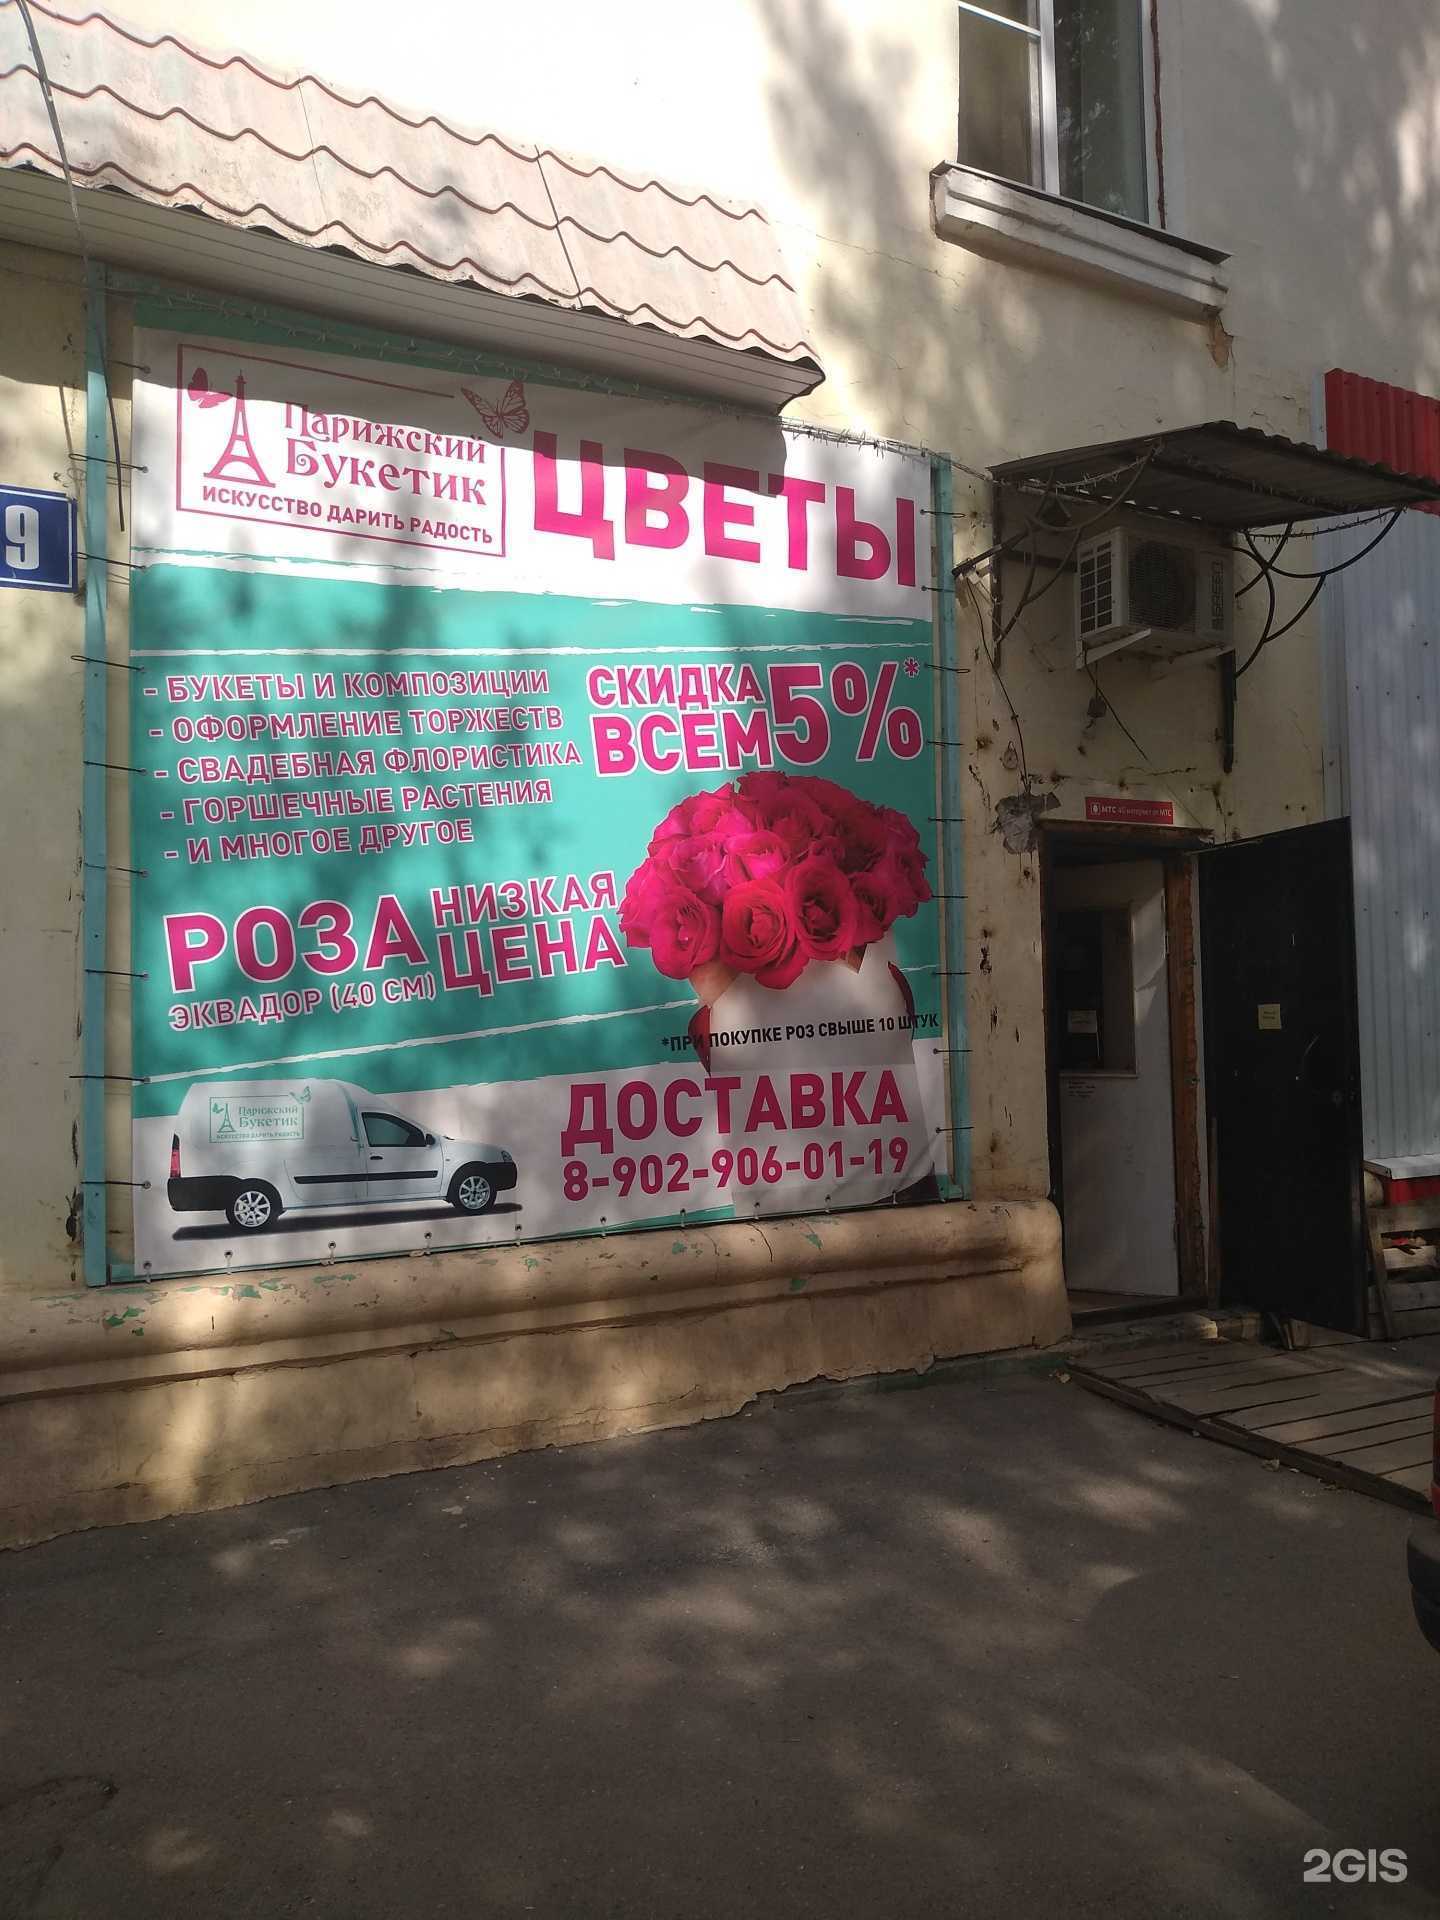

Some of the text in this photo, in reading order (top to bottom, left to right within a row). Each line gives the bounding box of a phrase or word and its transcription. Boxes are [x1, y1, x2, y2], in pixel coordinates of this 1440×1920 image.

[285, 399, 486, 463] Парижский
[286, 437, 487, 506] Букетик
[5, 505, 39, 570] 9
[202, 485, 492, 544] ИСКУССТВО ДАРИТЬ РАДОСТЬ
[533, 430, 916, 587] ЦВЕТЫ
[166, 673, 304, 703] БУКЕТЫ
[313, 673, 336, 699] И
[343, 669, 550, 700] КОМПОЗИЦИИ
[587, 663, 766, 711] СКИДКА
[172, 710, 402, 744] ОФОРМЛЕНИЕ
[408, 706, 564, 735] ТОРЖЕСТВ
[590, 708, 774, 776] ВСЕМ
[177, 750, 376, 786] СВАДЕБНАЯ
[384, 741, 582, 776] ФЛОРИСТИКА
[183, 787, 394, 825] ГОРШЕЧНЫЕ
[401, 779, 553, 813] РАСТЕНИЯ
[186, 837, 212, 864] И
[220, 827, 351, 862] МНОГОЕ
[360, 818, 474, 854] ДРУГОЕ
[431, 872, 618, 928] НИЗКАЯ
[162, 894, 429, 993] РОЗА
[437, 916, 627, 997] ЦЕНА
[168, 973, 437, 1031] ЭКВАДОР (40 СМ)
[709, 1026, 781, 1048] ПОКУПКЕ
[786, 1023, 815, 1041] РОЗ
[818, 1018, 876, 1037] СВЫШЕ
[879, 1016, 895, 1032] 10
[898, 1013, 939, 1030] ШТУК
[239, 1117, 298, 1129] Букетик
[560, 1069, 909, 1157] ДОСТАВКА
[562, 1137, 909, 1202] 8-902-906-01-19
